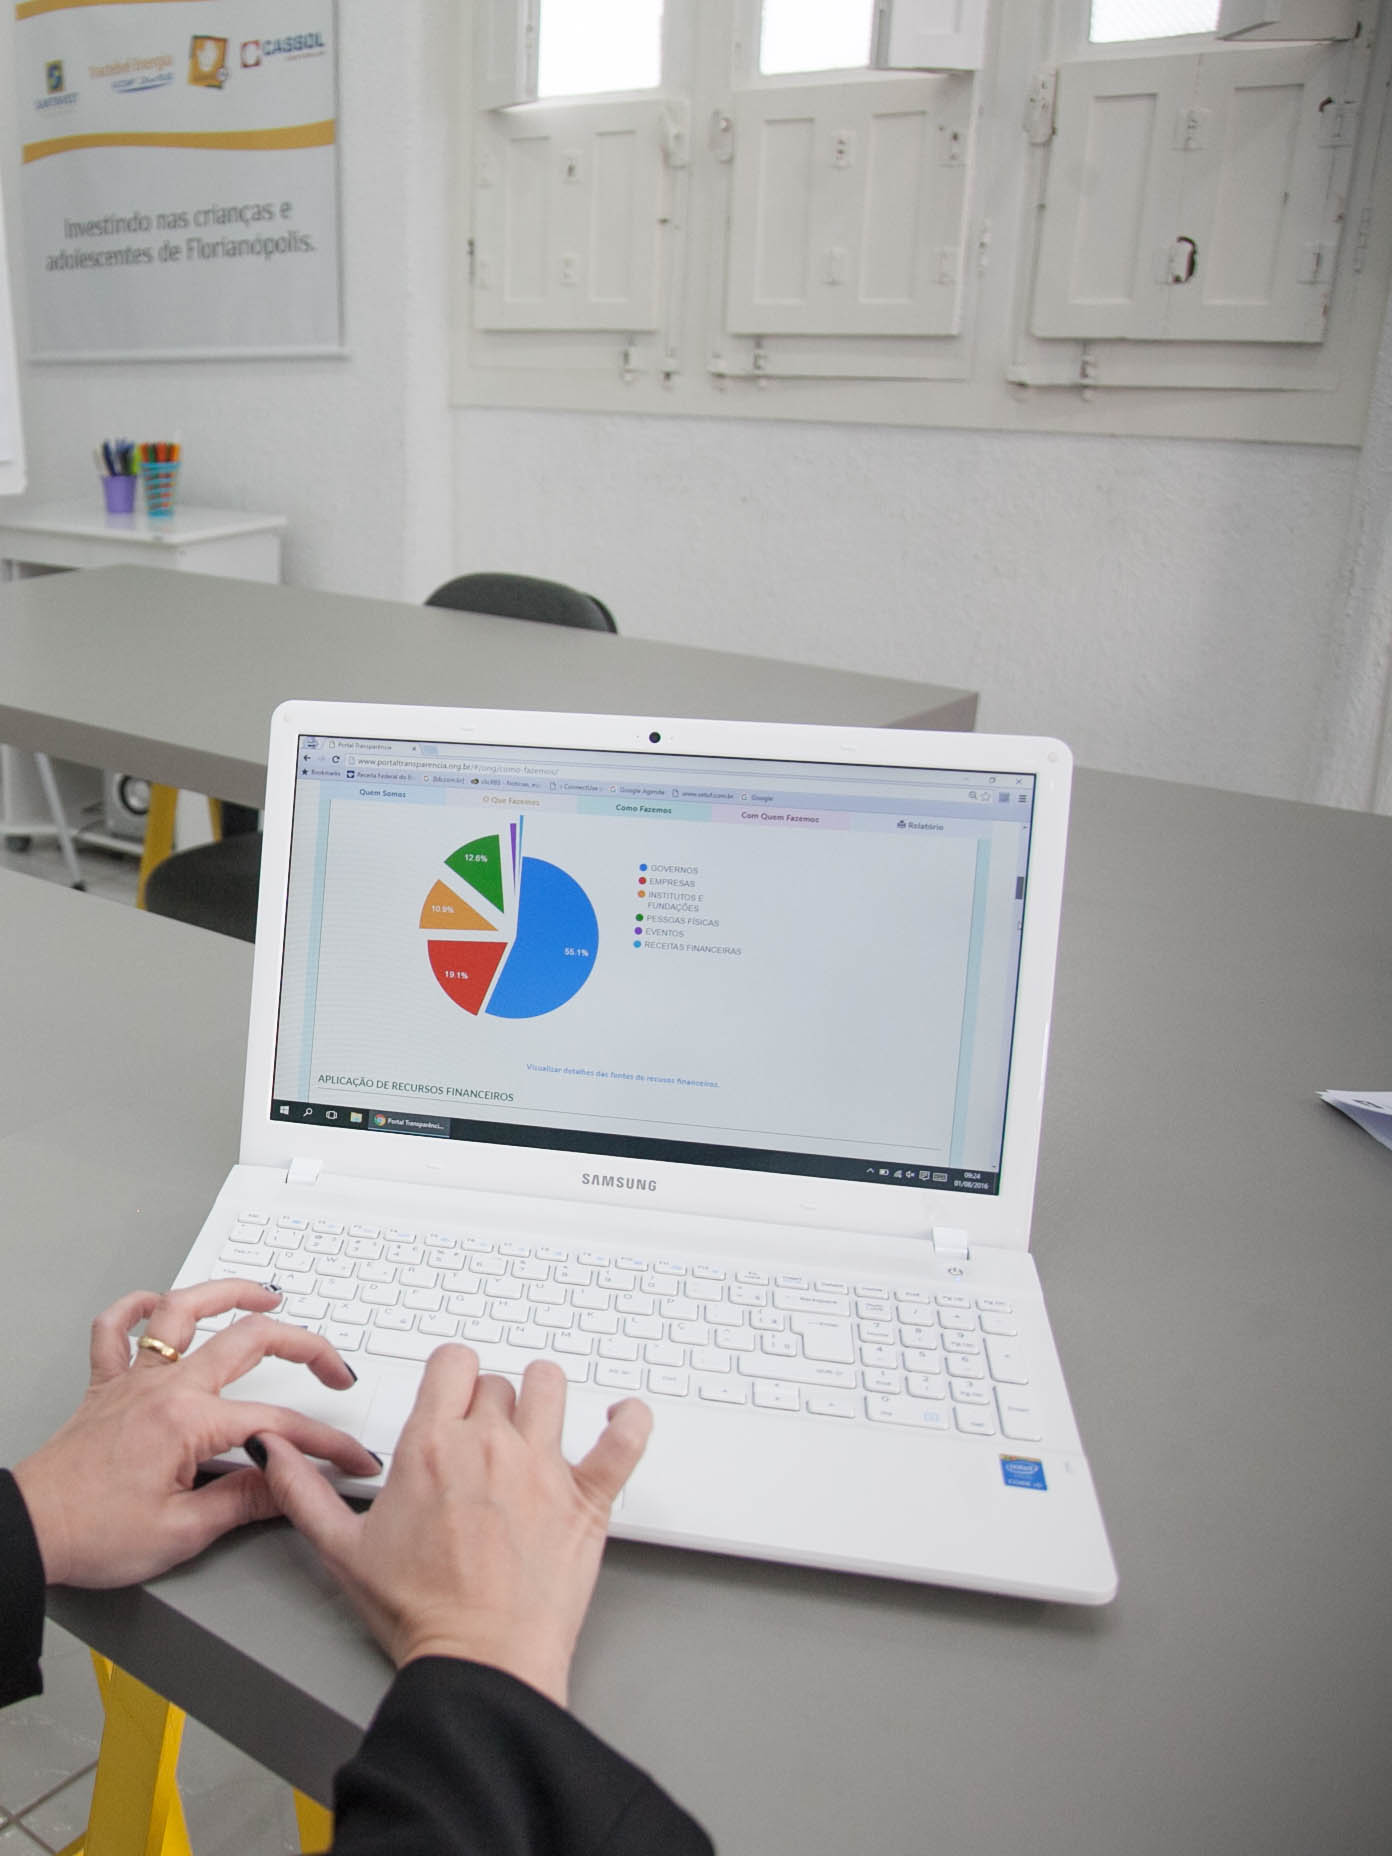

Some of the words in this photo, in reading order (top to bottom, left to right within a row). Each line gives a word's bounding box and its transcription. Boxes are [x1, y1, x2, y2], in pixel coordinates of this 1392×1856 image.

[64, 211, 152, 239] Investindo
[156, 211, 189, 231] nas
[193, 203, 274, 228] crianças
[279, 201, 294, 219] e
[46, 246, 153, 271] adolescentes
[158, 240, 184, 263] de
[359, 788, 381, 797] Quem
[382, 789, 407, 799] Somos
[490, 796, 507, 805] Que
[508, 796, 541, 806] Fazemos
[615, 803, 638, 812] Como
[639, 805, 672, 815] Fazemos
[741, 810, 759, 820] Com
[760, 811, 784, 821] Quem
[786, 814, 820, 824] Fazemos
[907, 821, 945, 831] Relatório
[650, 864, 699, 875] GOVERNOS
[649, 877, 696, 888] EMPRESAS
[648, 890, 697, 902] INSTITUTOS
[698, 894, 705, 903] E
[647, 902, 700, 913] FUNDAÇÕES
[646, 914, 686, 925] PESSOAS
[687, 917, 720, 928] FÍSICAS
[645, 927, 685, 938] EVENTOS
[644, 940, 686, 951] RECEITAS
[686, 945, 742, 956] FINANCEIRAS
[318, 1073, 374, 1089] APLICAÇÃO
[376, 1079, 390, 1090] DE
[391, 1081, 444, 1095] RECURSOS
[446, 1087, 515, 1102] FINANCEIROS
[387, 1117, 405, 1126] Portal
[581, 1173, 657, 1191] SAMSUNG
